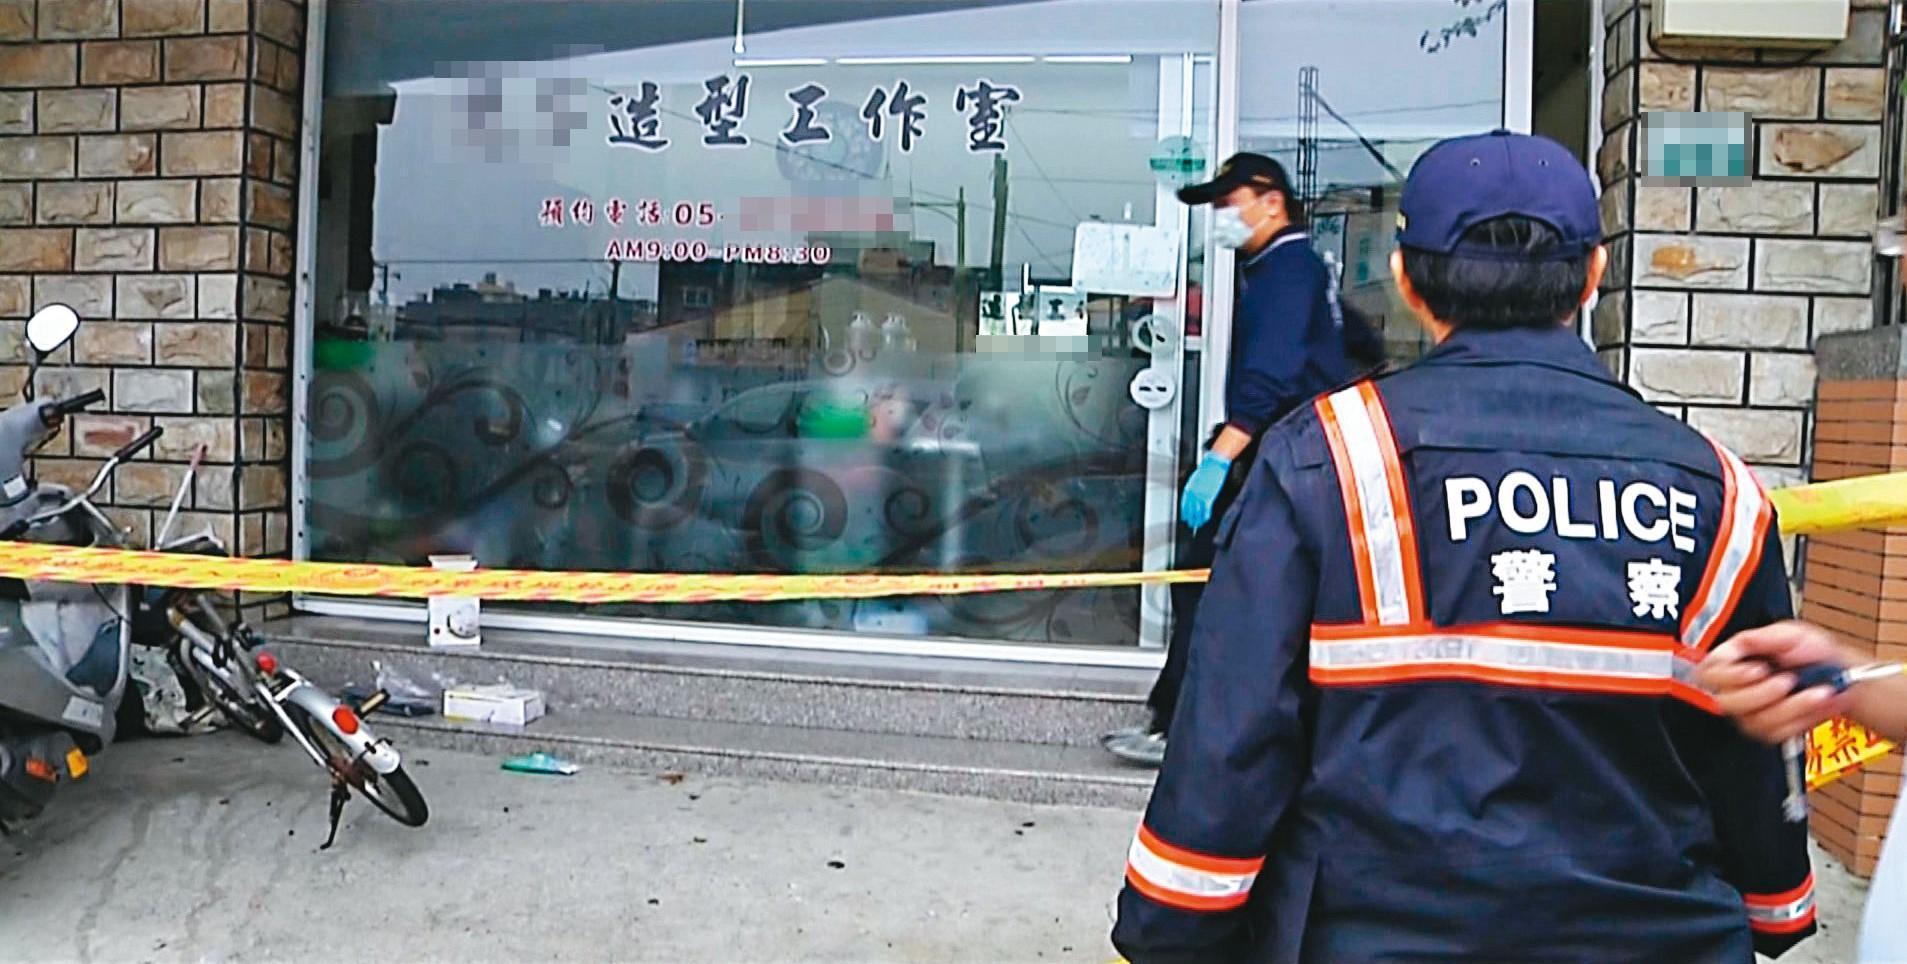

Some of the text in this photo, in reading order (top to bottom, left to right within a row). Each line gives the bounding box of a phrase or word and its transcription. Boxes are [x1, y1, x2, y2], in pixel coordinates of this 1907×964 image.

[607, 74, 1022, 152] 造型工作室
[1445, 471, 1697, 553] POLICE
[1491, 549, 1681, 620] 警察
